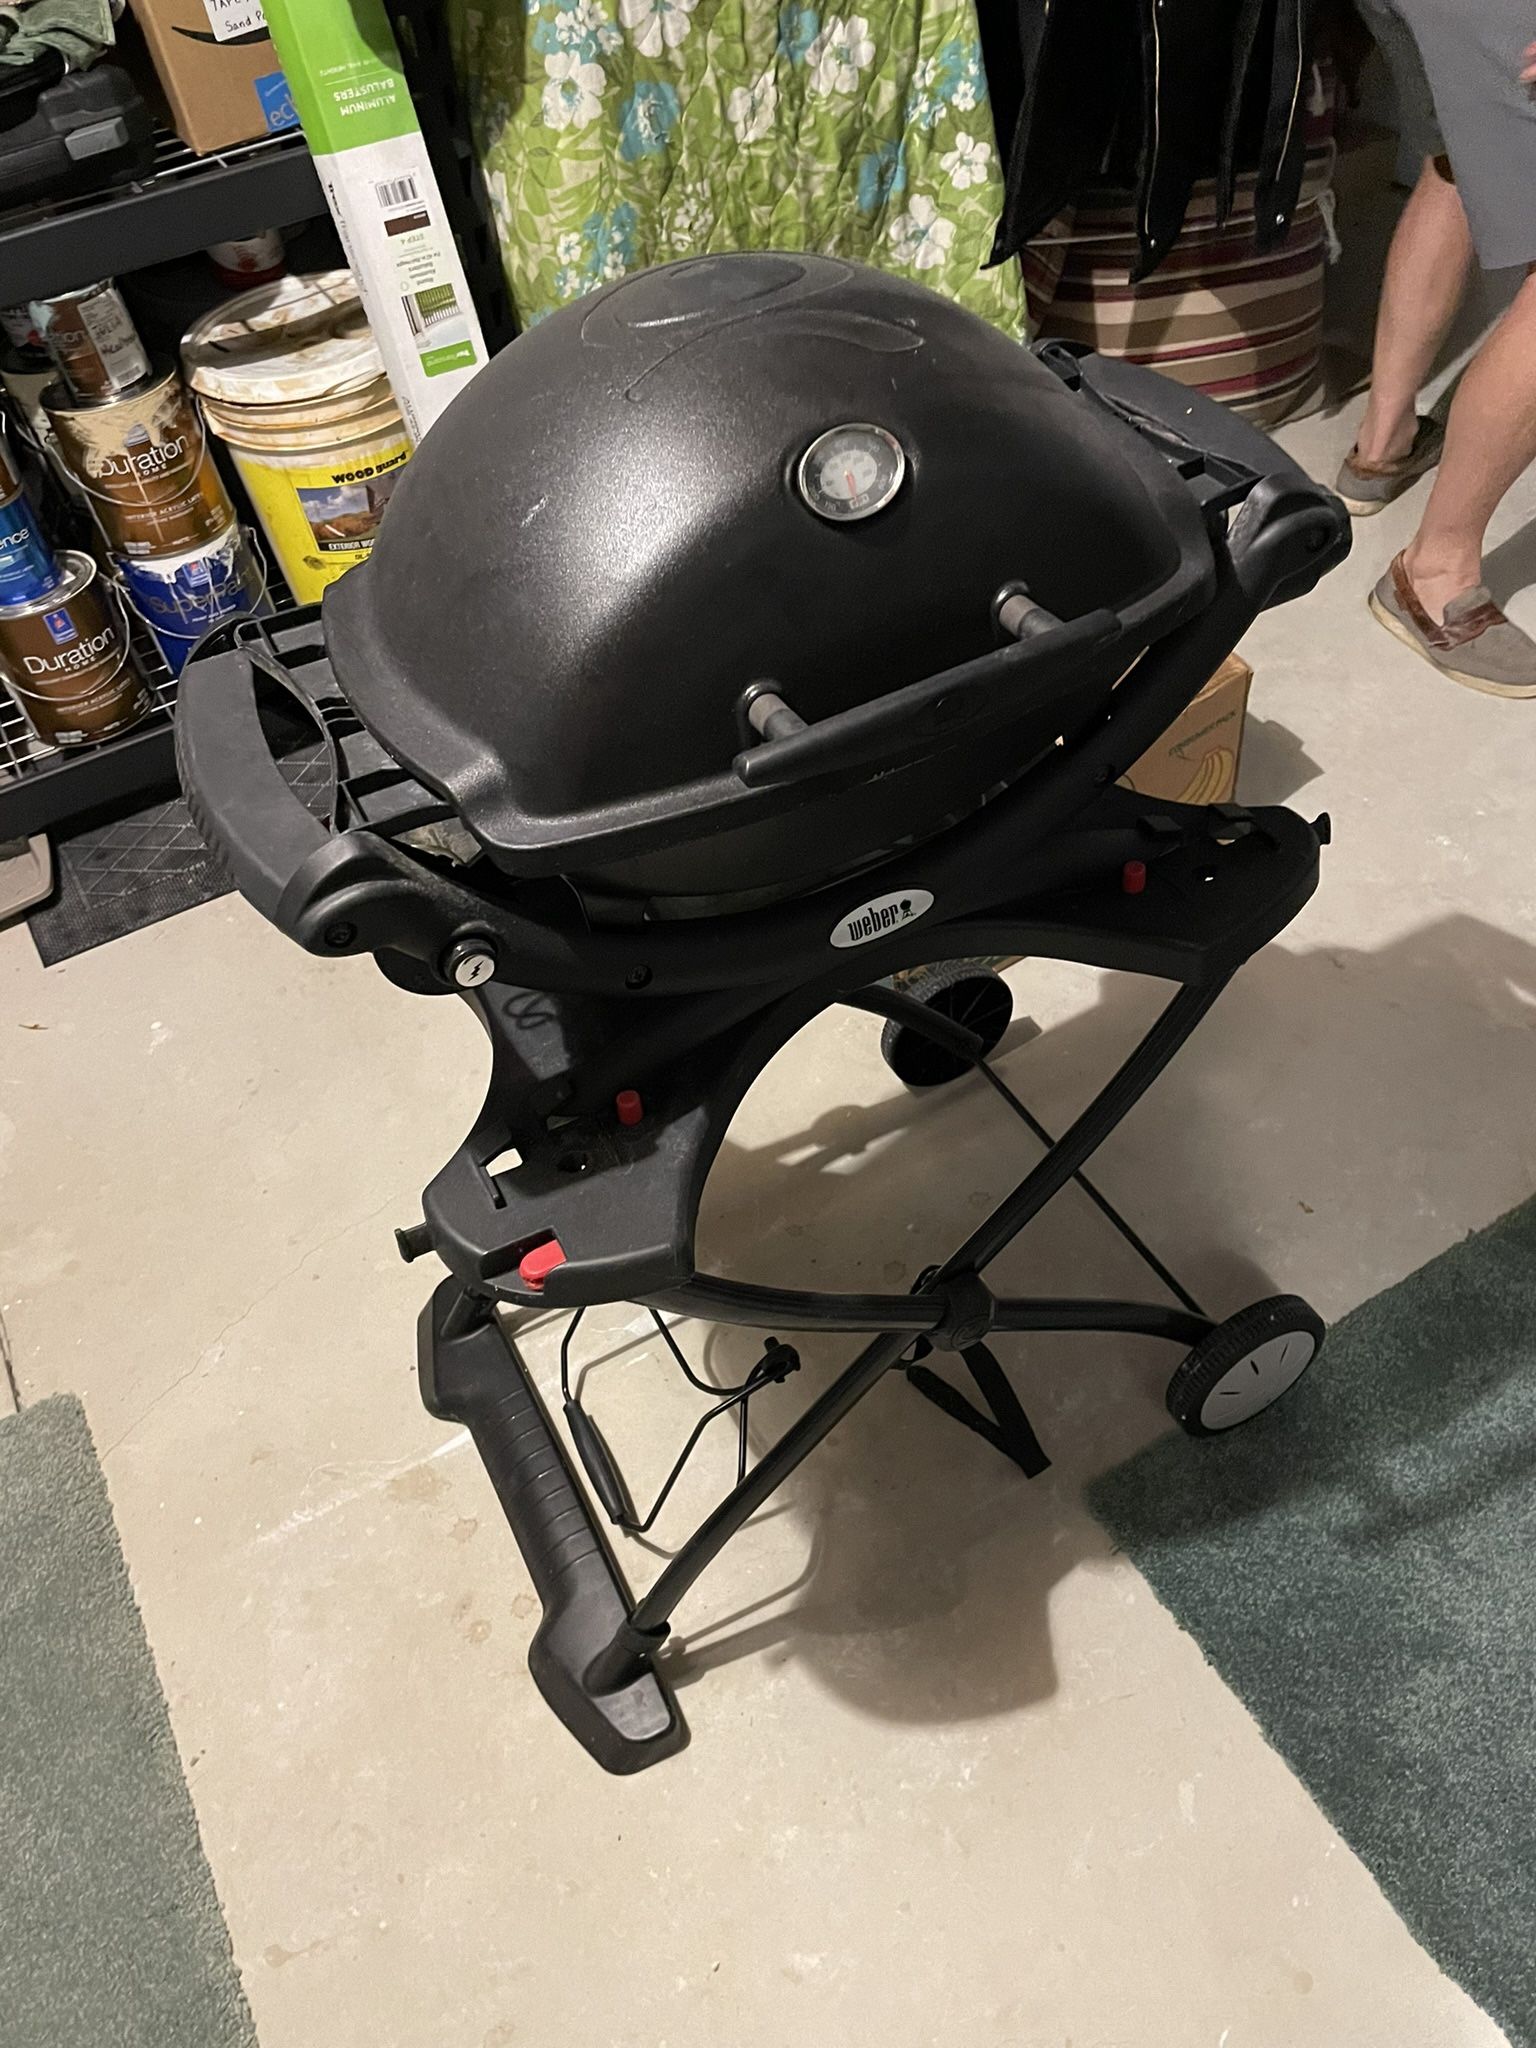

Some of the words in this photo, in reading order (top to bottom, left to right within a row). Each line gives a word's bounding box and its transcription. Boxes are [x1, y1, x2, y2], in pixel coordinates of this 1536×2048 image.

[210, 0, 241, 11] TA
[224, 15, 252, 32] Sand
[333, 78, 395, 102] BALUSTERS
[339, 94, 396, 116] ALUMINUM
[331, 467, 374, 484] WOOD
[375, 451, 407, 474] guard
[0, 528, 30, 550] nce
[23, 627, 116, 675] Duration
[847, 903, 899, 942] weber
